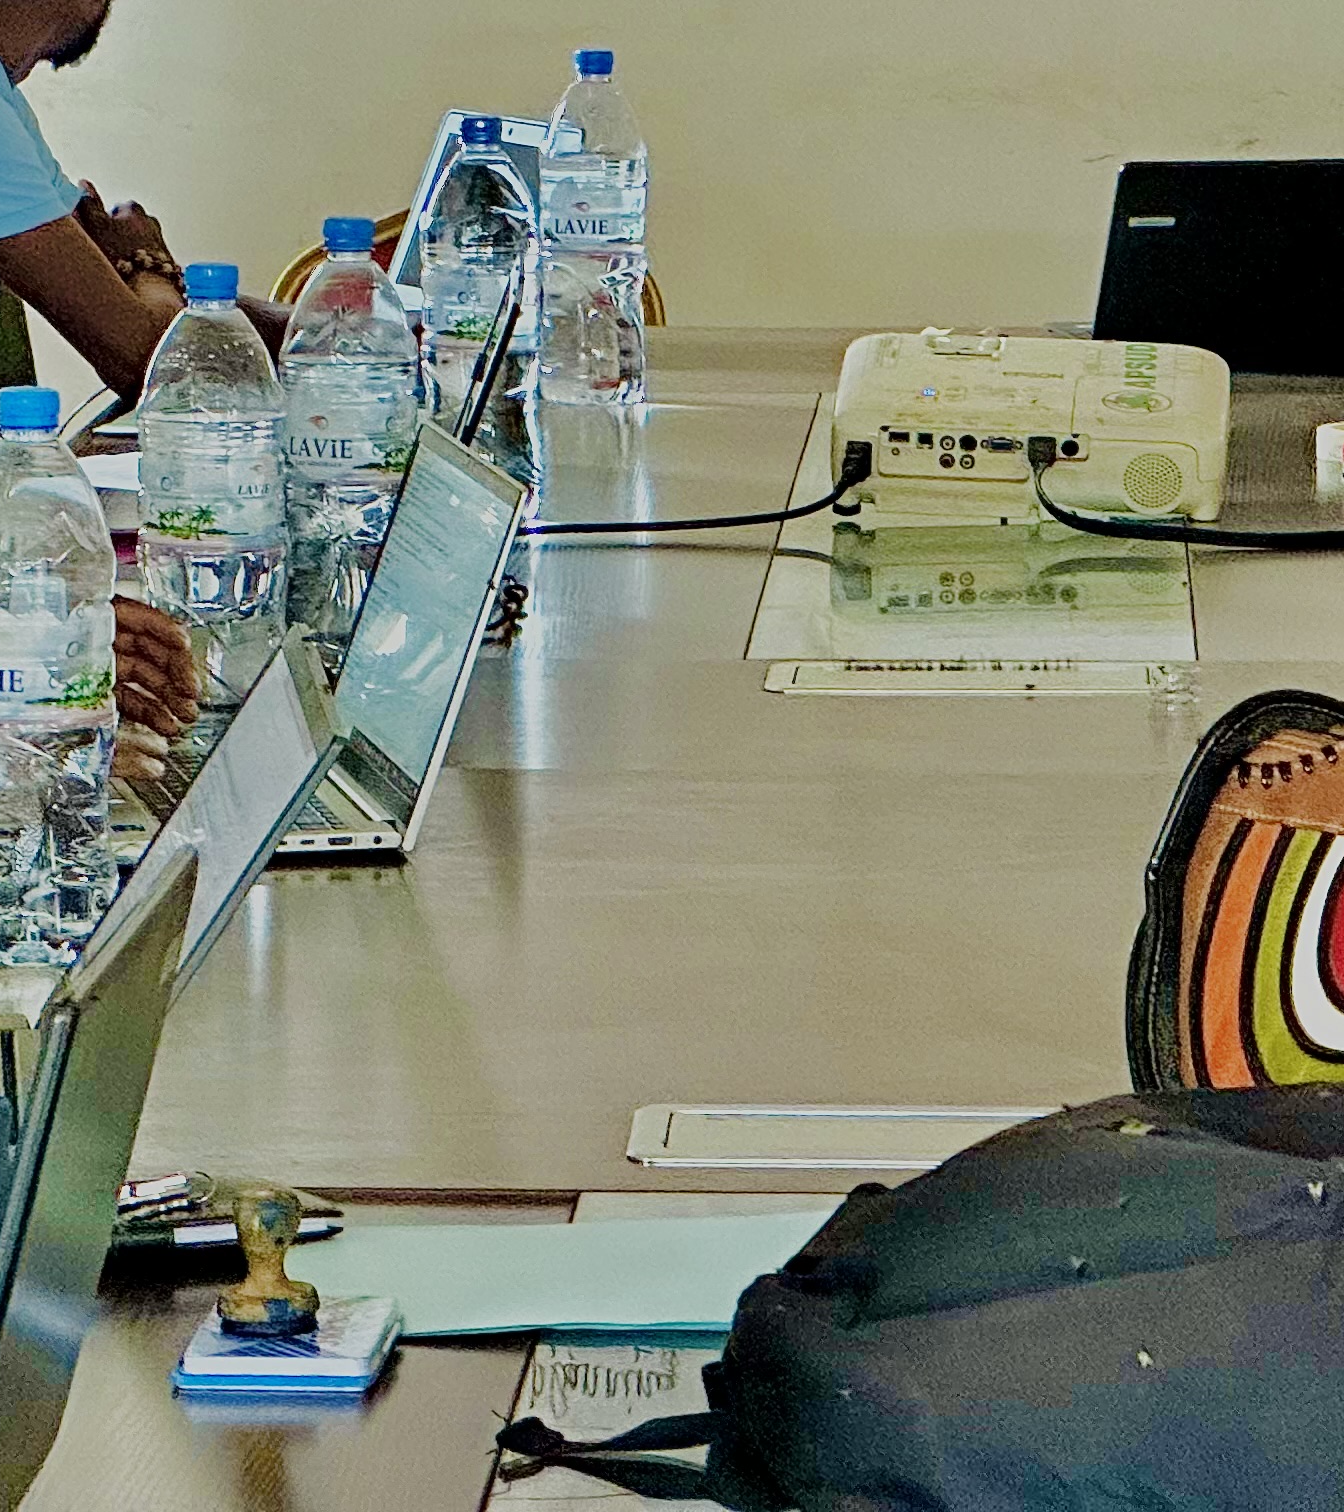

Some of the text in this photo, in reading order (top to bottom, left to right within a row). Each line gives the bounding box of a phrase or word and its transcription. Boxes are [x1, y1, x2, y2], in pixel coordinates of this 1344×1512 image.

[555, 219, 609, 235] LAVIE
[1124, 344, 1157, 390] APSUD
[290, 436, 353, 459] LAVIE
